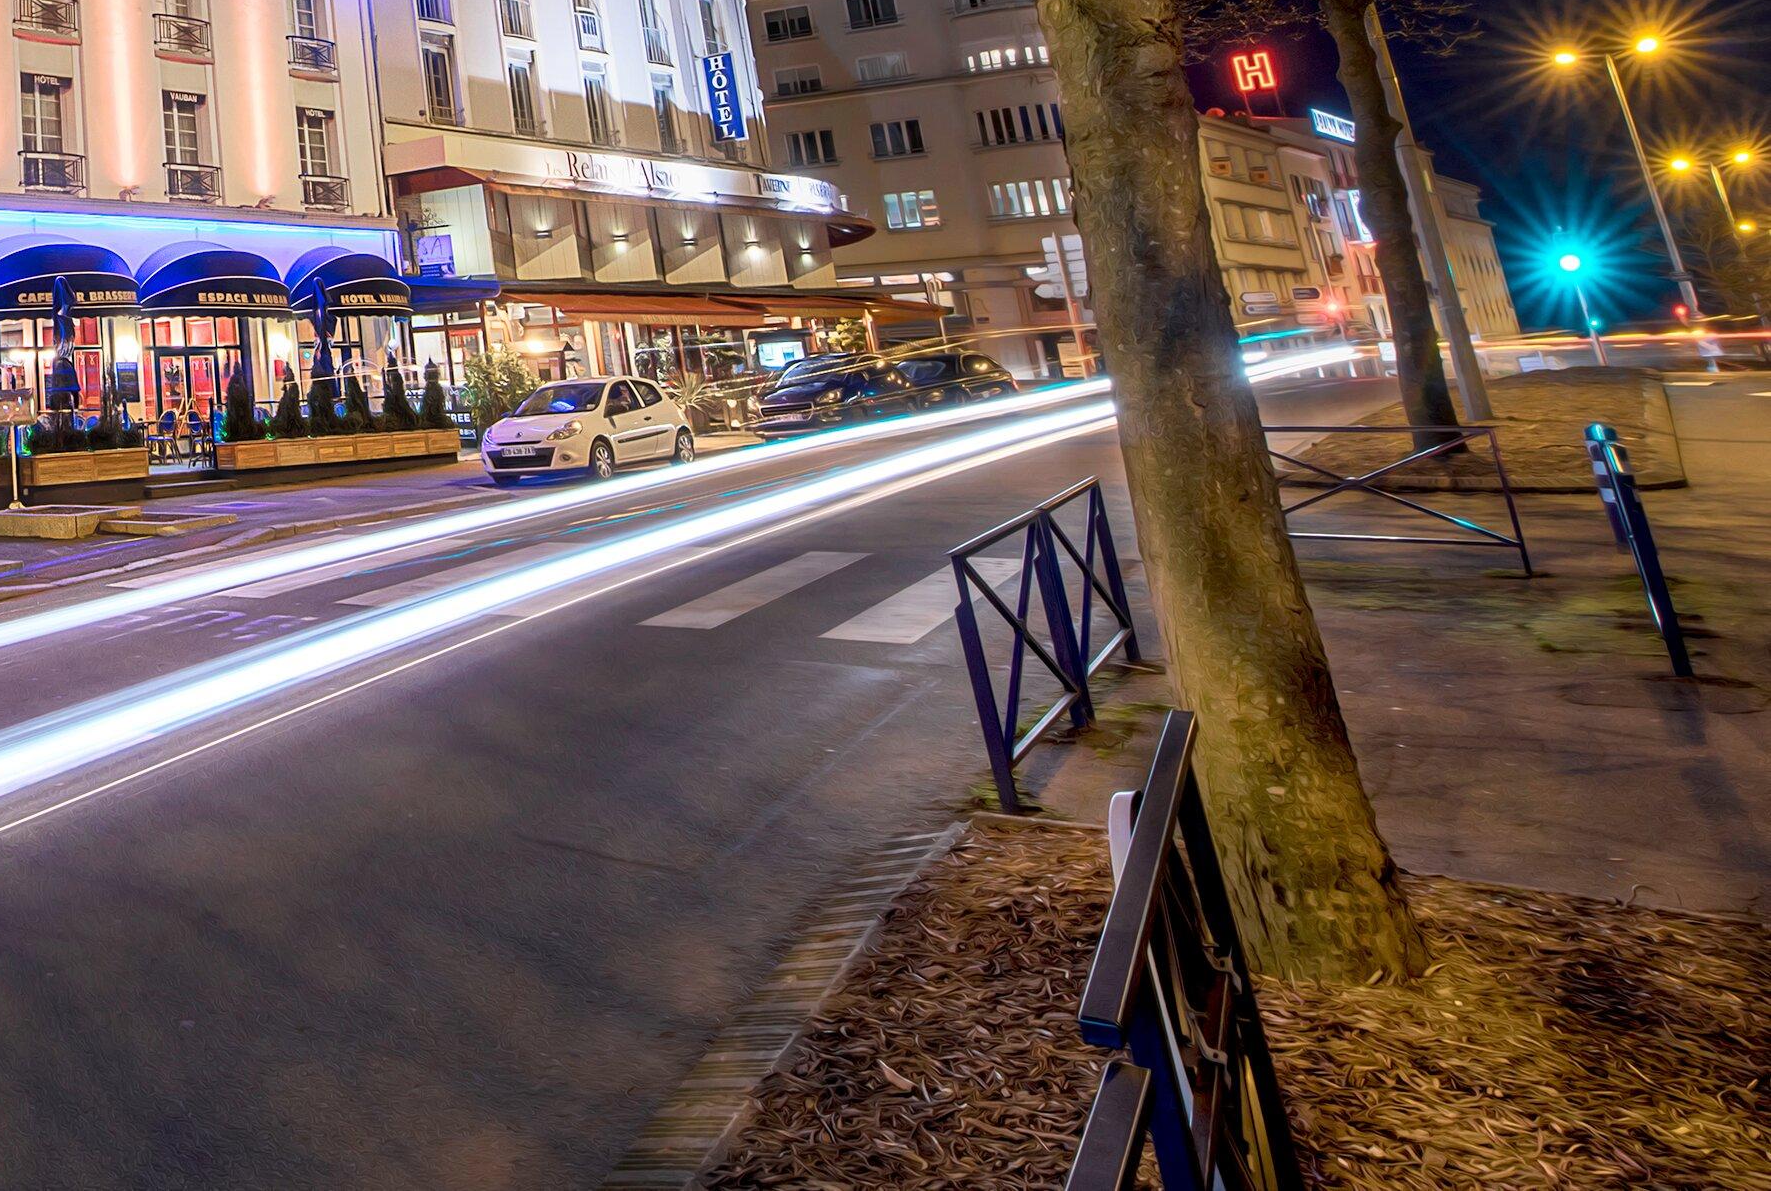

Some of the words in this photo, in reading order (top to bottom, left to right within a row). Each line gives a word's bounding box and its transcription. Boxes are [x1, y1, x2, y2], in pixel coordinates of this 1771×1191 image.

[1232, 51, 1275, 91] H
[34, 73, 60, 86] HOTEL
[169, 91, 197, 104] VAUBAN
[708, 55, 736, 138] HÔTEL
[304, 108, 326, 118] HOTEL
[18, 292, 53, 303] CAFE
[198, 292, 248, 303] ESPACE
[340, 293, 377, 304] HOTEL
[446, 413, 471, 423] REE
